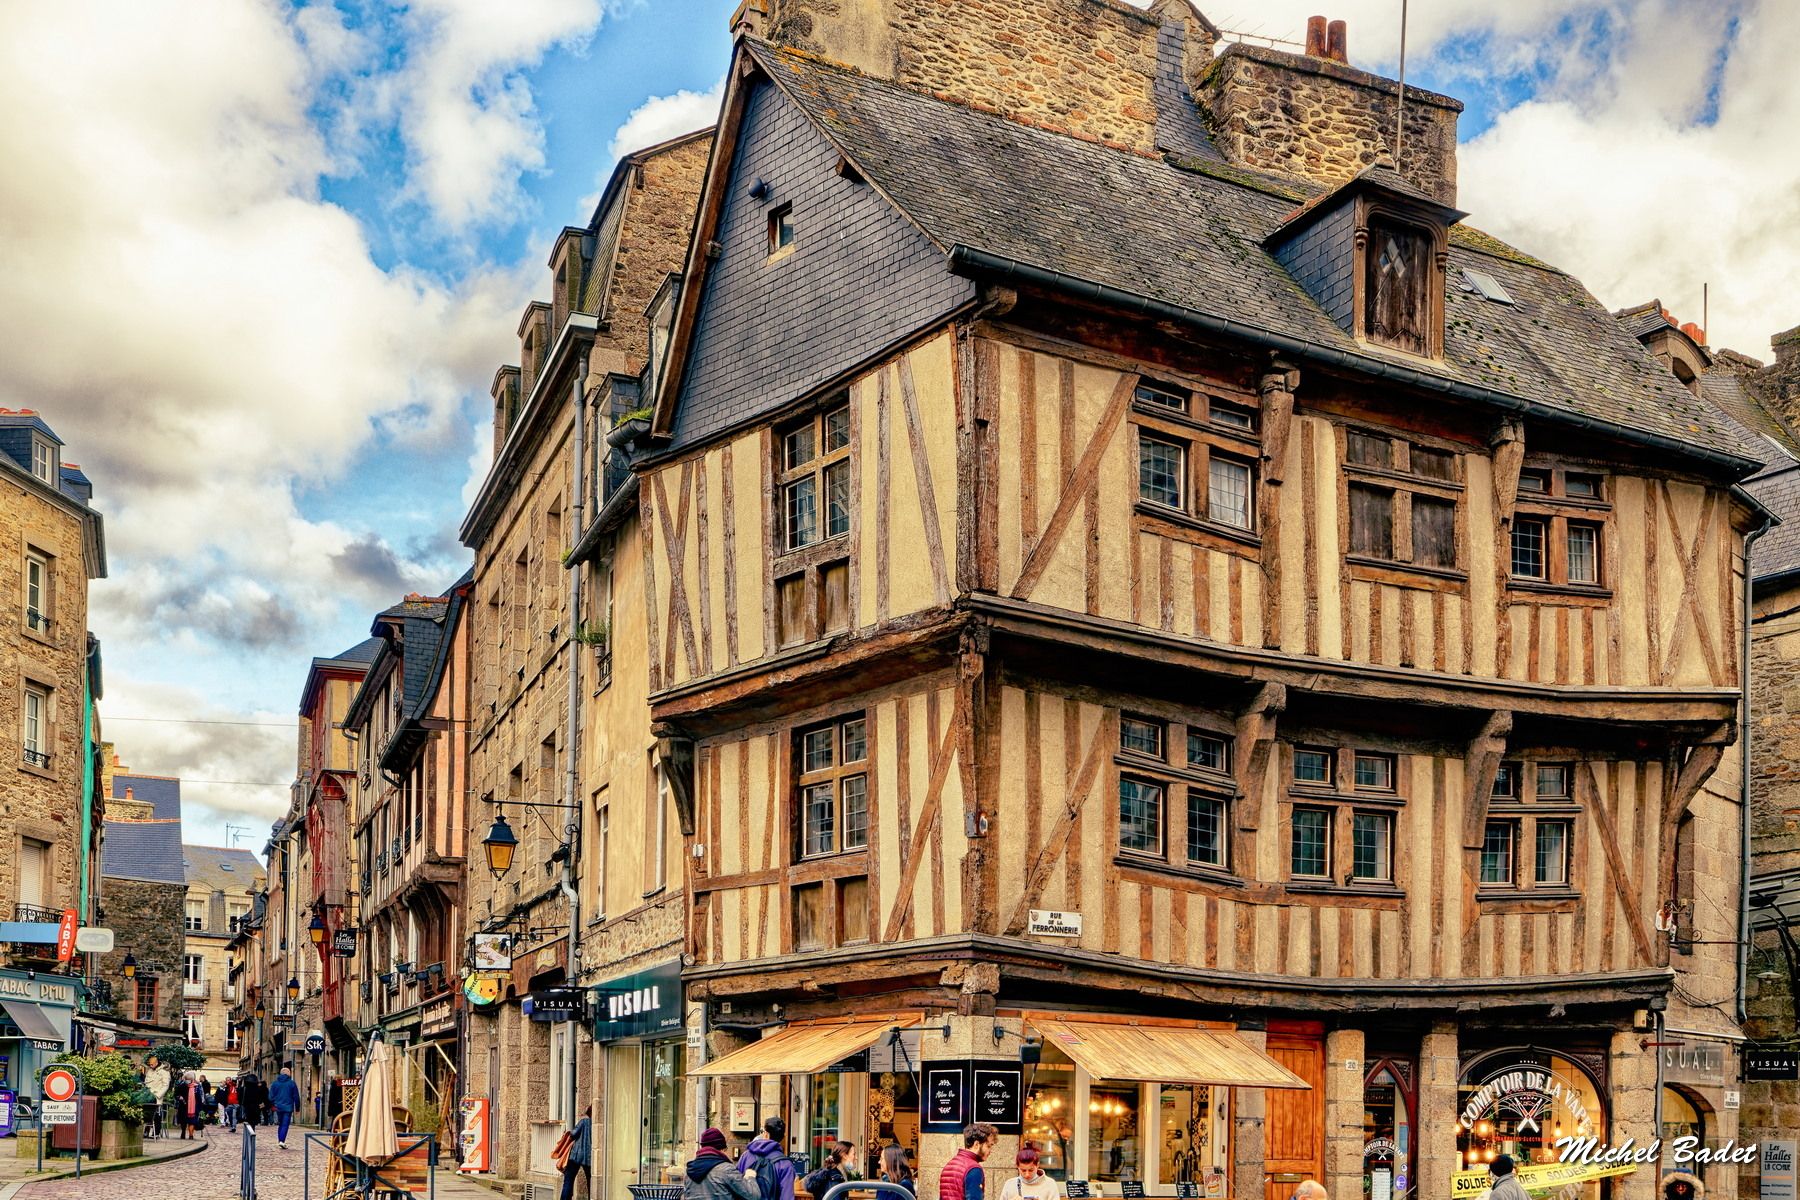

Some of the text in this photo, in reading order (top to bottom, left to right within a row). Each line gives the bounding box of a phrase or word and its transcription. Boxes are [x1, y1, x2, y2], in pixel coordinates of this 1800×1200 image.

[61, 914, 73, 955] TABAC
[1032, 924, 1079, 935] FERRONNERIE
[335, 935, 355, 944] Halles
[40, 983, 66, 1000] PMU
[534, 1000, 581, 1008] VISUAL
[609, 986, 661, 1019] VISUAL
[33, 1040, 58, 1051] TABAC
[1749, 1060, 1797, 1068] VISUAL
[1460, 1071, 1524, 1130] COMPTOIR
[1526, 1071, 1545, 1090] DE
[1545, 1076, 1561, 1099] LA
[1563, 1088, 1594, 1135] VAPE
[43, 1113, 75, 1122] RUE PIETONNE
[1764, 1149, 1792, 1161] Halles
[1547, 1166, 1587, 1181] SOLDES
[1457, 1178, 1493, 1191] SOLDES
